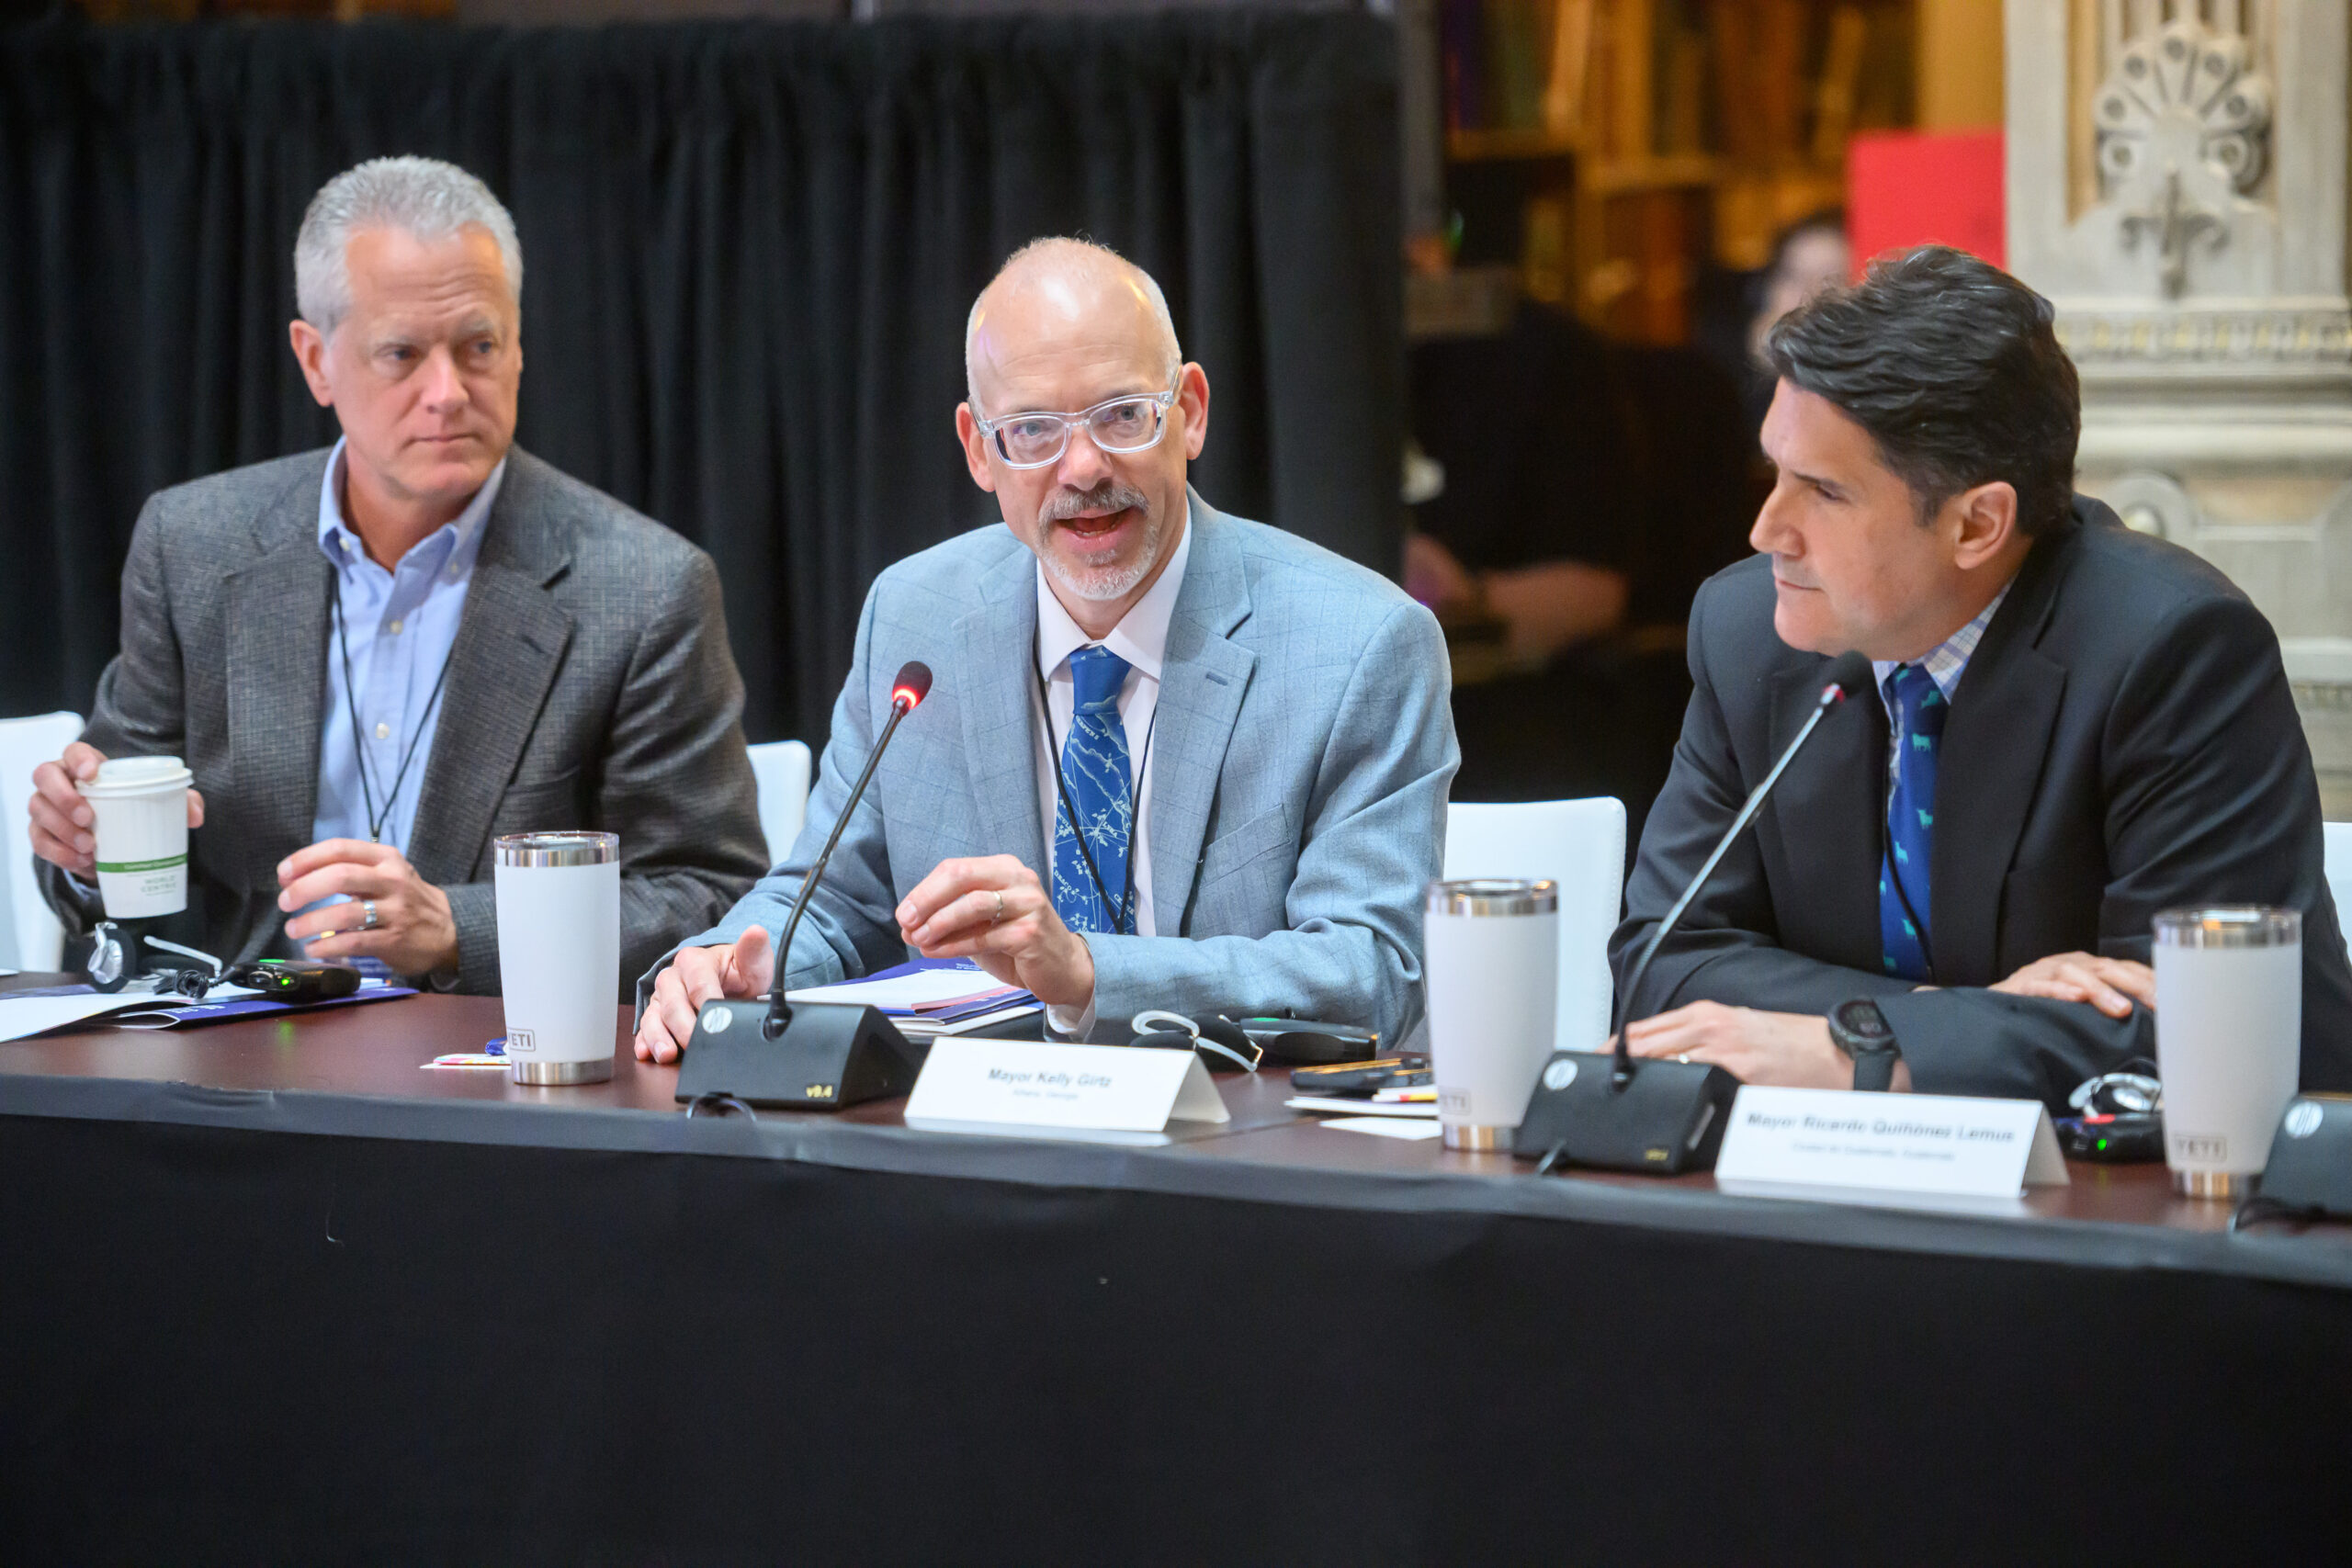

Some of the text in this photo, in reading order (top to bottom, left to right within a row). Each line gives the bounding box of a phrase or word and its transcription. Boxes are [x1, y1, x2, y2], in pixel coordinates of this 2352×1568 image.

[1054, 869, 1072, 891] DRACO
[988, 1068, 1032, 1084] Mayor
[1037, 1072, 1072, 1087] Kelly
[1747, 1112, 1796, 1130] Mayor
[1804, 1116, 1866, 1133] Ricardo
[1958, 1124, 2015, 1142] Lemus
[2177, 1139, 2222, 1157] YETI
